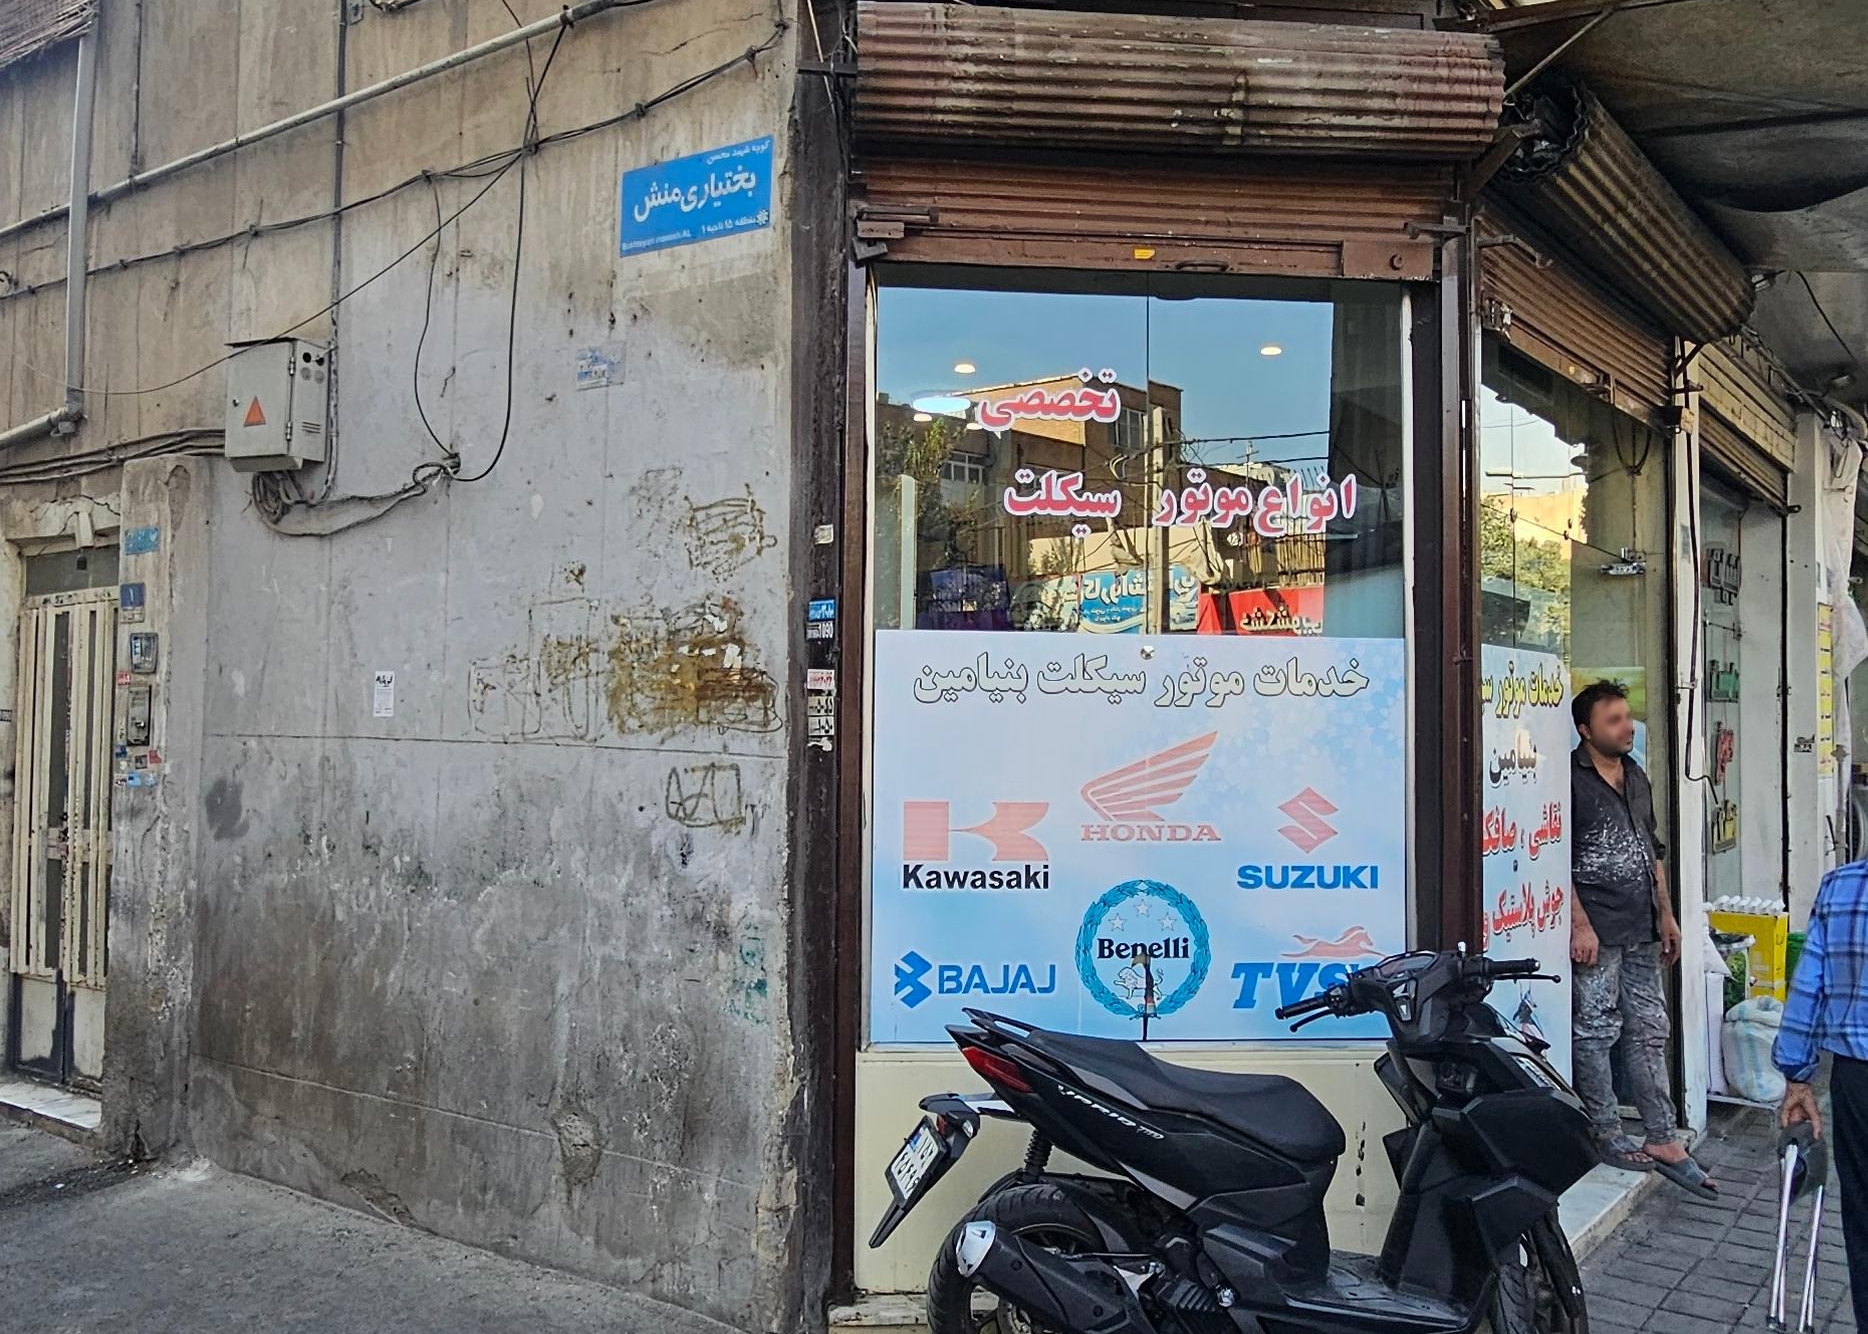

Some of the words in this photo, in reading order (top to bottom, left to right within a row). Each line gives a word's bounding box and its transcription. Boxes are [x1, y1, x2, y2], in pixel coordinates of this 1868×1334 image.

[978, 367, 1121, 431] تخصصی
[1004, 468, 1122, 539] سیکلت
[1151, 467, 1253, 528] موتور
[1253, 472, 1357, 537] انواع
[913, 651, 1029, 704] بنیامین
[1037, 653, 1147, 705] سیکلت
[1153, 656, 1245, 708] موتور
[1253, 656, 1370, 697] خدمات
[1495, 660, 1526, 718] موتور
[1528, 662, 1563, 707] خدمات
[1489, 731, 1537, 787] بنیامین
[1080, 824, 1221, 843] HONDA
[1483, 805, 1516, 856] صافک
[1528, 802, 1562, 860] نقاشی
[902, 864, 1050, 891] Kawasaki
[1237, 864, 1379, 890] SUZUKI
[1492, 882, 1535, 942] پلاستیک
[1537, 880, 1563, 932] جوش
[1097, 937, 1190, 959] Benelli
[938, 964, 1056, 995] BAJAJ
